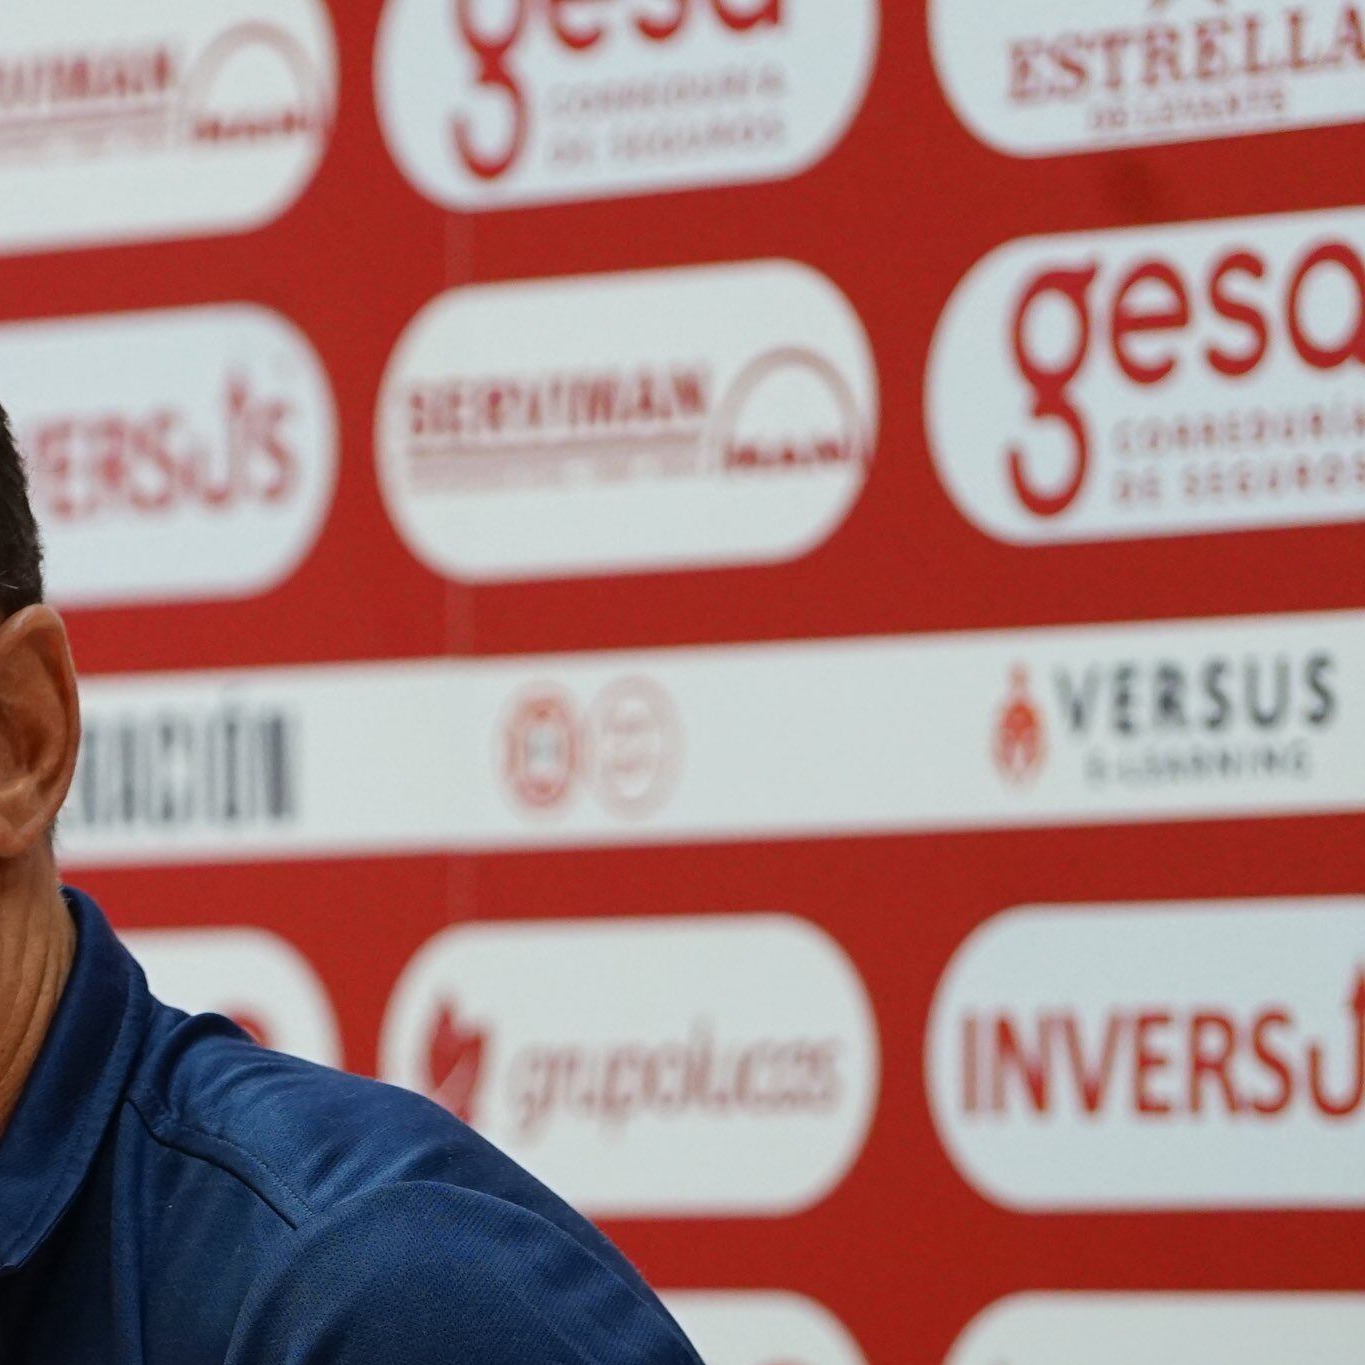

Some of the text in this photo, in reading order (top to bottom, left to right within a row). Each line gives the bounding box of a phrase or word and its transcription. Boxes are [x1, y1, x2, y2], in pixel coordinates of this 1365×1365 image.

[1005, 5, 1365, 104] ESTRELLA
[1006, 241, 1365, 517] gesa
[1052, 652, 1337, 736] VERSUS
